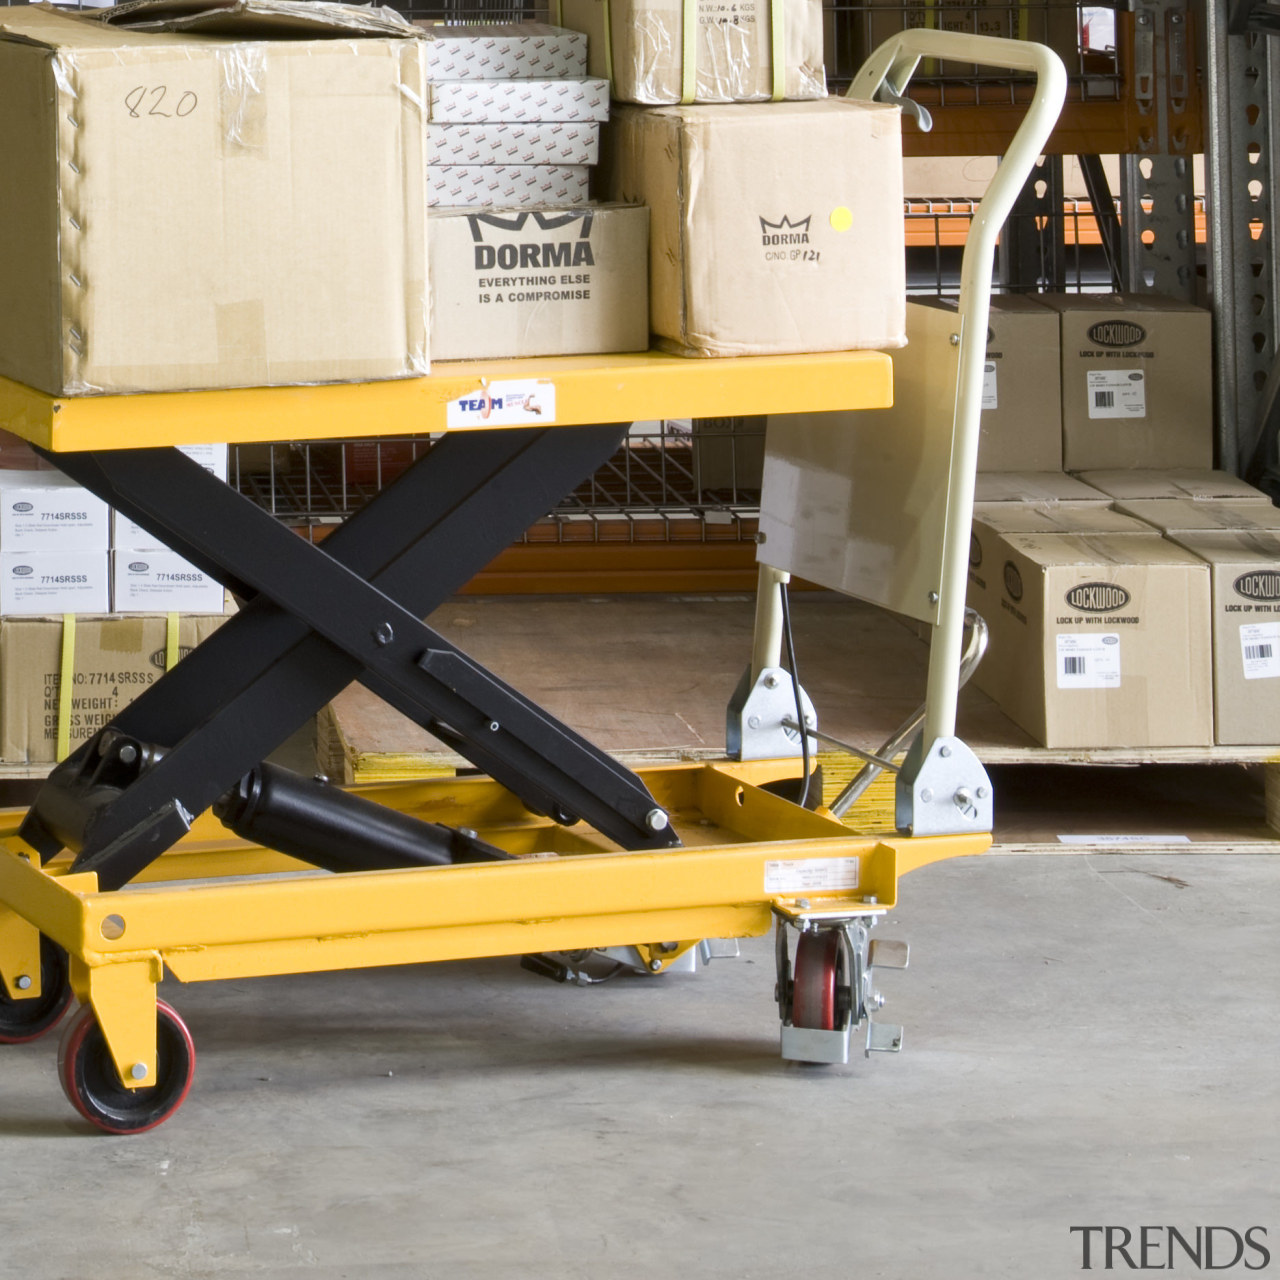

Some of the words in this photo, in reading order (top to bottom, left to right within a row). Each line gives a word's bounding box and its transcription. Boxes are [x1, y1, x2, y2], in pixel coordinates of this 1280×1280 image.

[124, 86, 198, 118] 820
[762, 233, 810, 245] DORMA
[475, 241, 594, 270] DORMA
[479, 276, 556, 288] EVERYTHING
[561, 274, 590, 284] ELSE
[479, 294, 491, 303] IS
[495, 293, 504, 302] A
[508, 290, 590, 302] COMPROMISE
[1092, 325, 1142, 346] LOCKWOOD
[41, 512, 87, 521] 7714SRSSS
[41, 575, 87, 583] 7714SRSSS
[156, 574, 203, 582] 7714SRSSS
[1071, 587, 1125, 610] LOCKWOOD
[1086, 616, 1102, 624] WITH
[1105, 616, 1139, 624] LOCKWOOD
